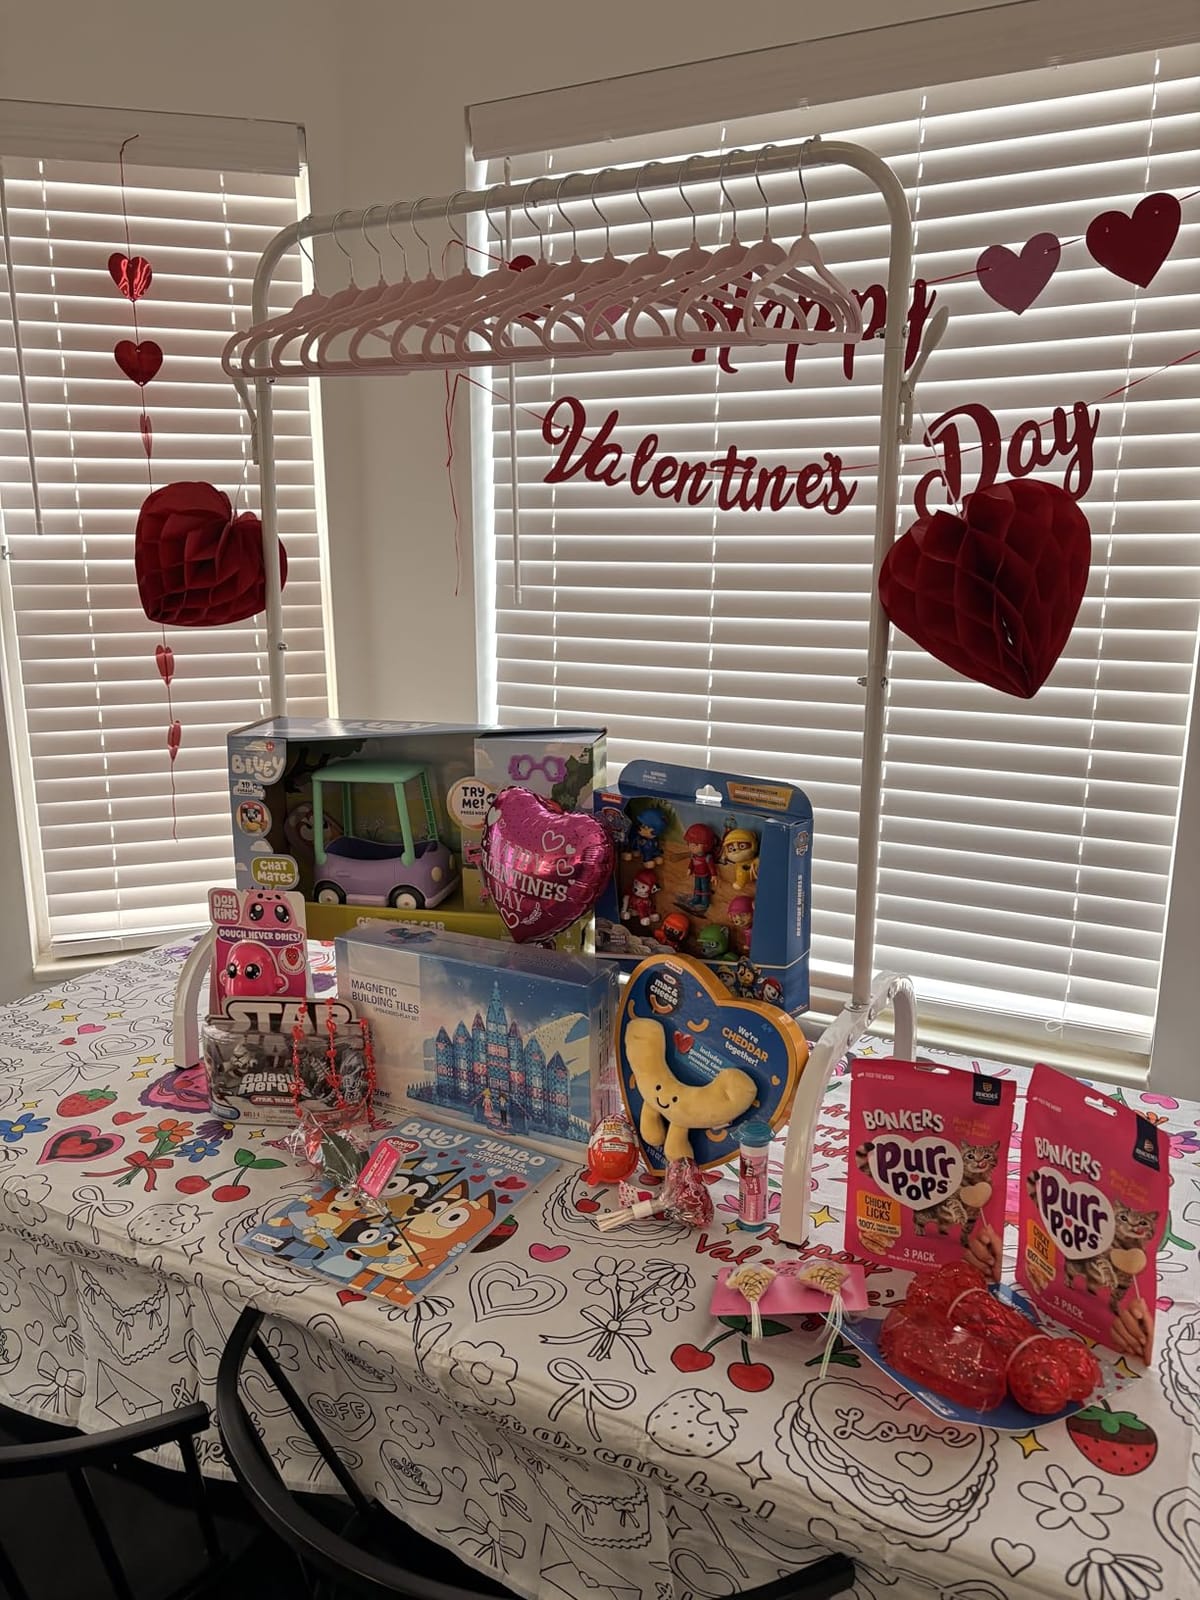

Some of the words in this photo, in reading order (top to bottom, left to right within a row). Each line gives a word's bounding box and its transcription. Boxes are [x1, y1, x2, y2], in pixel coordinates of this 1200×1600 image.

[542, 396, 857, 515] Valentine's
[913, 401, 1100, 518] Day
[231, 754, 284, 784] BLUEY
[461, 786, 485, 798] TRY
[494, 879, 524, 912] DAY
[220, 929, 247, 939] DOUGH
[248, 930, 273, 940] NEVER
[351, 979, 397, 997] MAGNETIC
[352, 992, 393, 1008] BUILDING
[395, 1001, 419, 1014] TILES
[209, 1001, 363, 1035] STAR
[722, 1027, 769, 1061] CHEDDAR
[738, 1026, 759, 1043] We're
[724, 1042, 759, 1067] together!
[862, 1109, 945, 1132] BONKERS
[400, 1122, 471, 1149] BLUEY
[466, 1153, 504, 1169] ACTIVITY
[504, 1163, 530, 1175] BOOK
[474, 1140, 546, 1167] JUMBO
[1034, 1136, 1102, 1181] BONKERS
[864, 1195, 892, 1210] CHICKY
[866, 1207, 891, 1222] LICKS
[903, 1247, 911, 1257] 3
[912, 1249, 935, 1263] PACK
[1053, 1295, 1060, 1304] 3
[1061, 1296, 1084, 1320] PACK
[317, 1400, 365, 1420] BFF
[832, 1406, 977, 1450] Love
